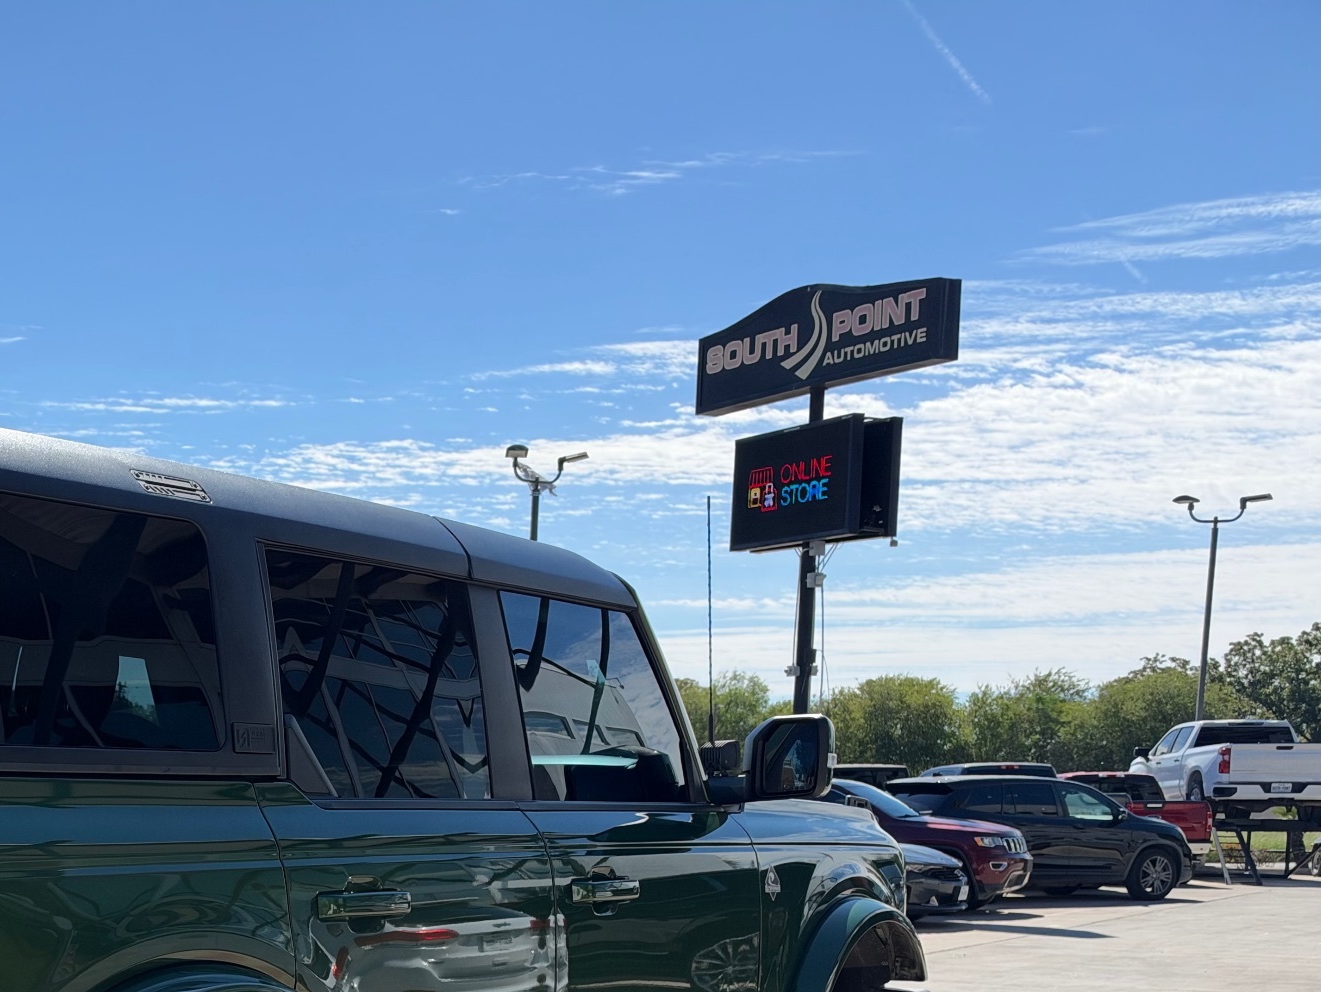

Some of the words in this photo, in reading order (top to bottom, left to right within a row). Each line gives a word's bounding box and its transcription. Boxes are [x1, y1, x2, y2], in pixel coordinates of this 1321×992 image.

[705, 323, 798, 375] SOUTH
[831, 288, 926, 342] POINT
[822, 328, 927, 366] AUTOMOTIVE
[780, 455, 832, 483] ONLINE
[780, 478, 829, 506] STORE
